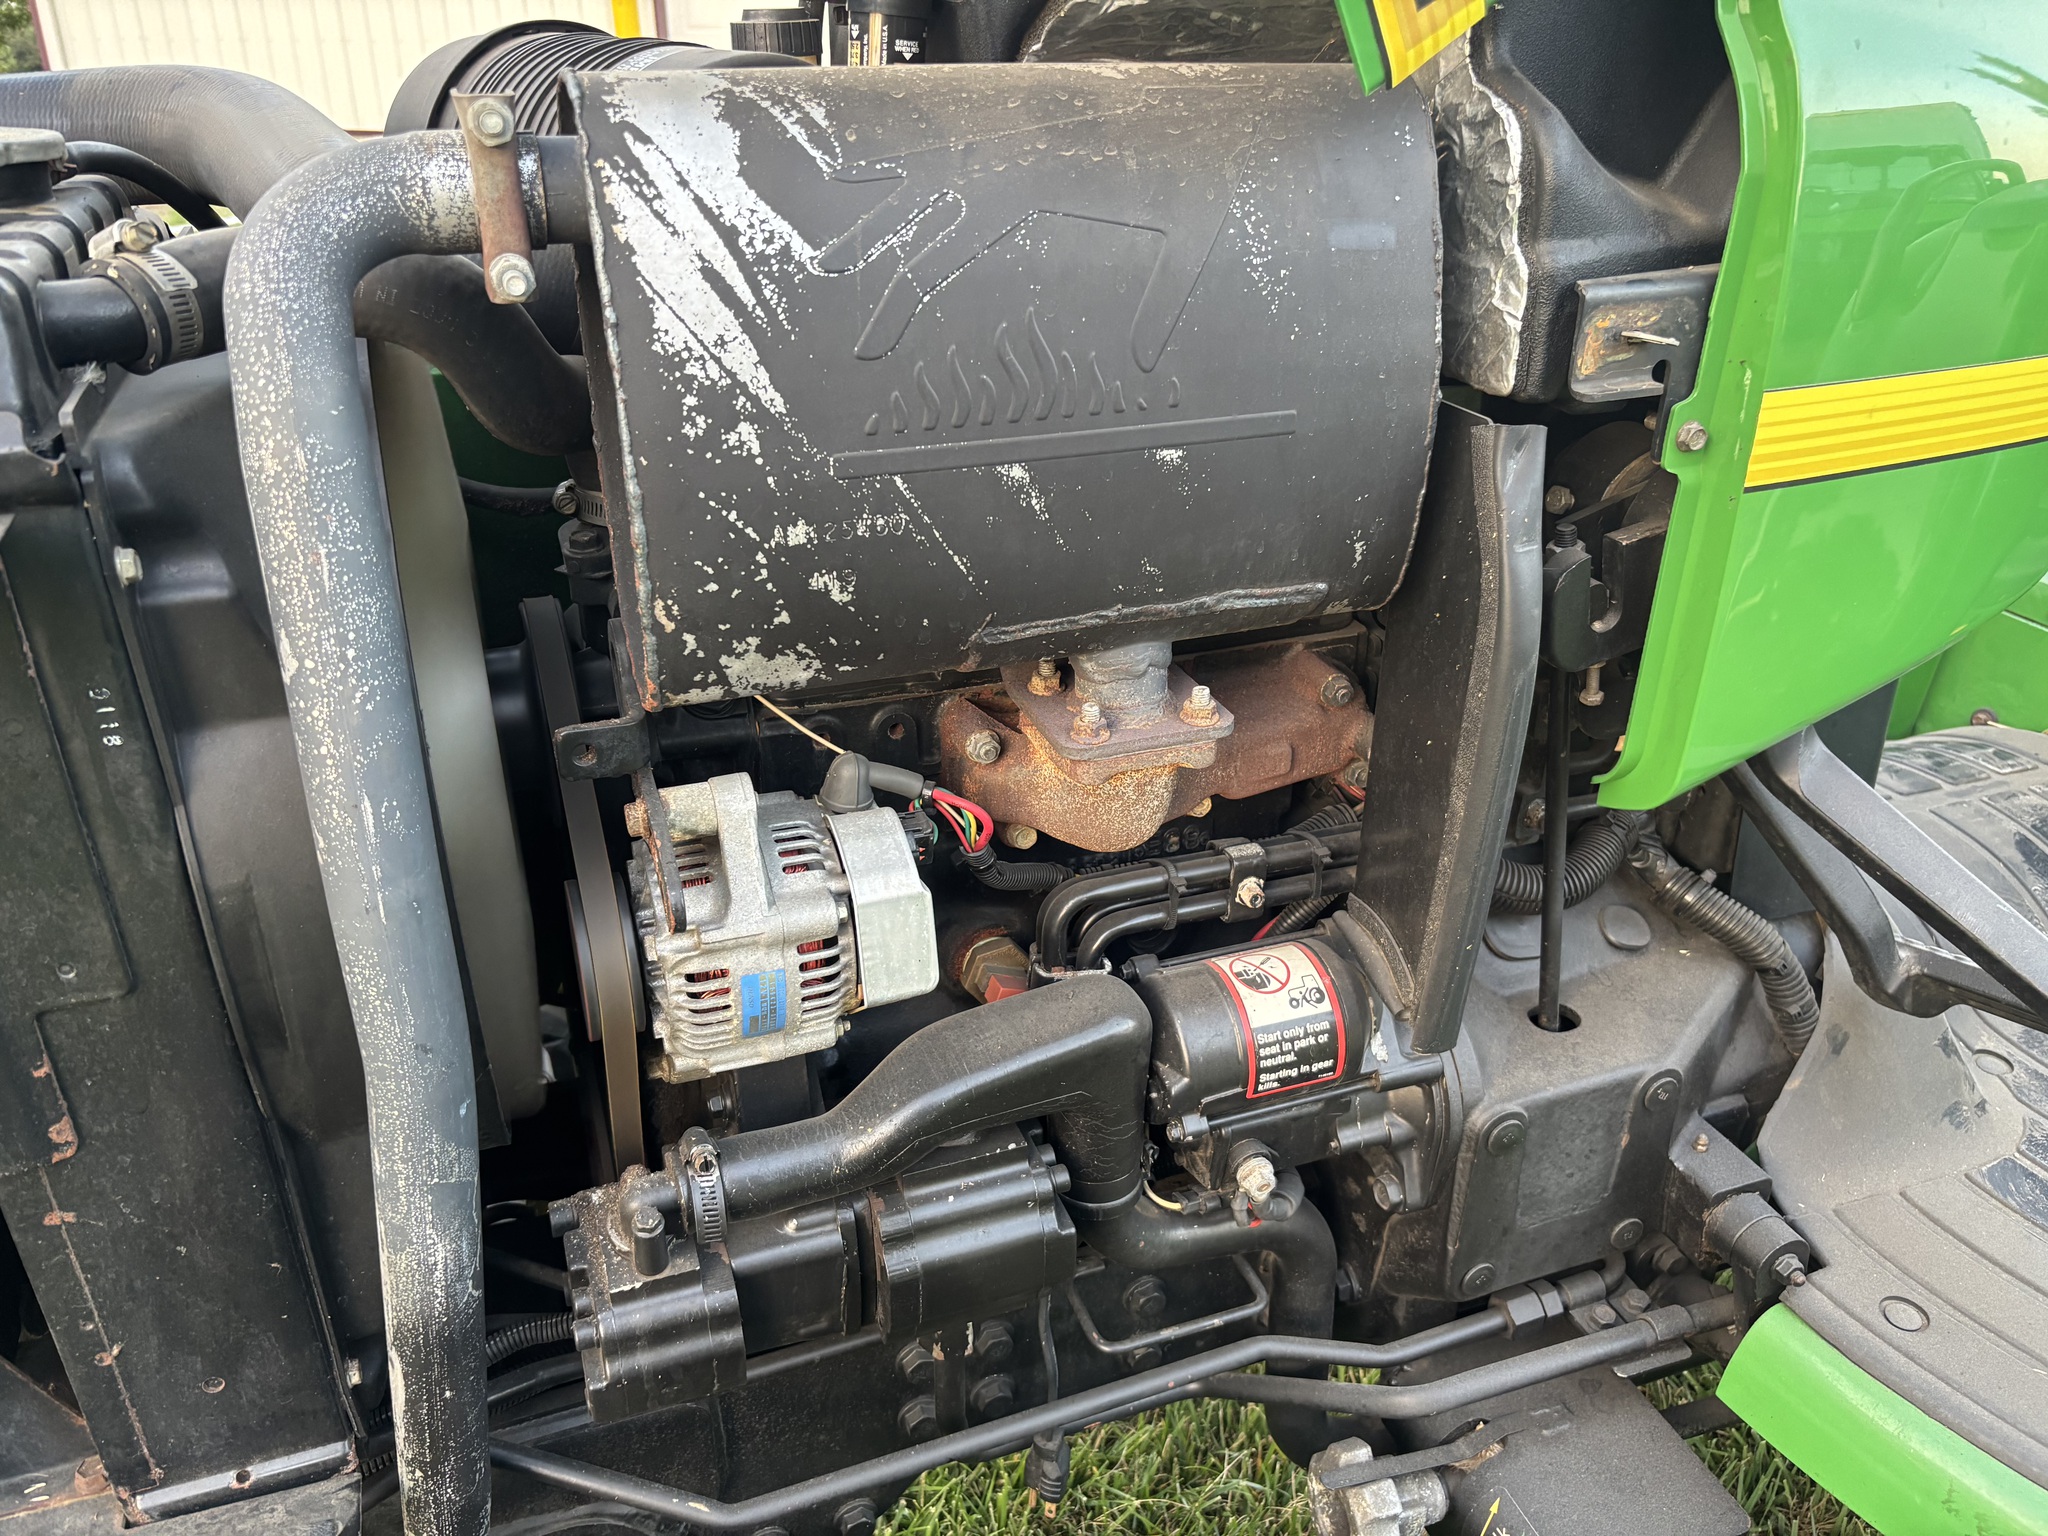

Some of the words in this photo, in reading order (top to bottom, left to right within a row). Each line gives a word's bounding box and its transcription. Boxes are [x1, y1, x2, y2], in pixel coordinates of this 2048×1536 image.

[895, 39, 919, 47] SERVICE
[1257, 1030, 1282, 1044] Start
[1283, 1025, 1304, 1038] only
[1306, 1020, 1330, 1033] from
[1259, 1043, 1281, 1057] seat
[1282, 1041, 1292, 1051] in
[1293, 1034, 1316, 1051] park
[1317, 1033, 1329, 1043] or
[1260, 1051, 1297, 1068] neutral.
[1259, 1067, 1298, 1083] Starting
[1300, 1064, 1310, 1073] in
[1311, 1059, 1334, 1072] gear
[1257, 1081, 1280, 1092] kills.
